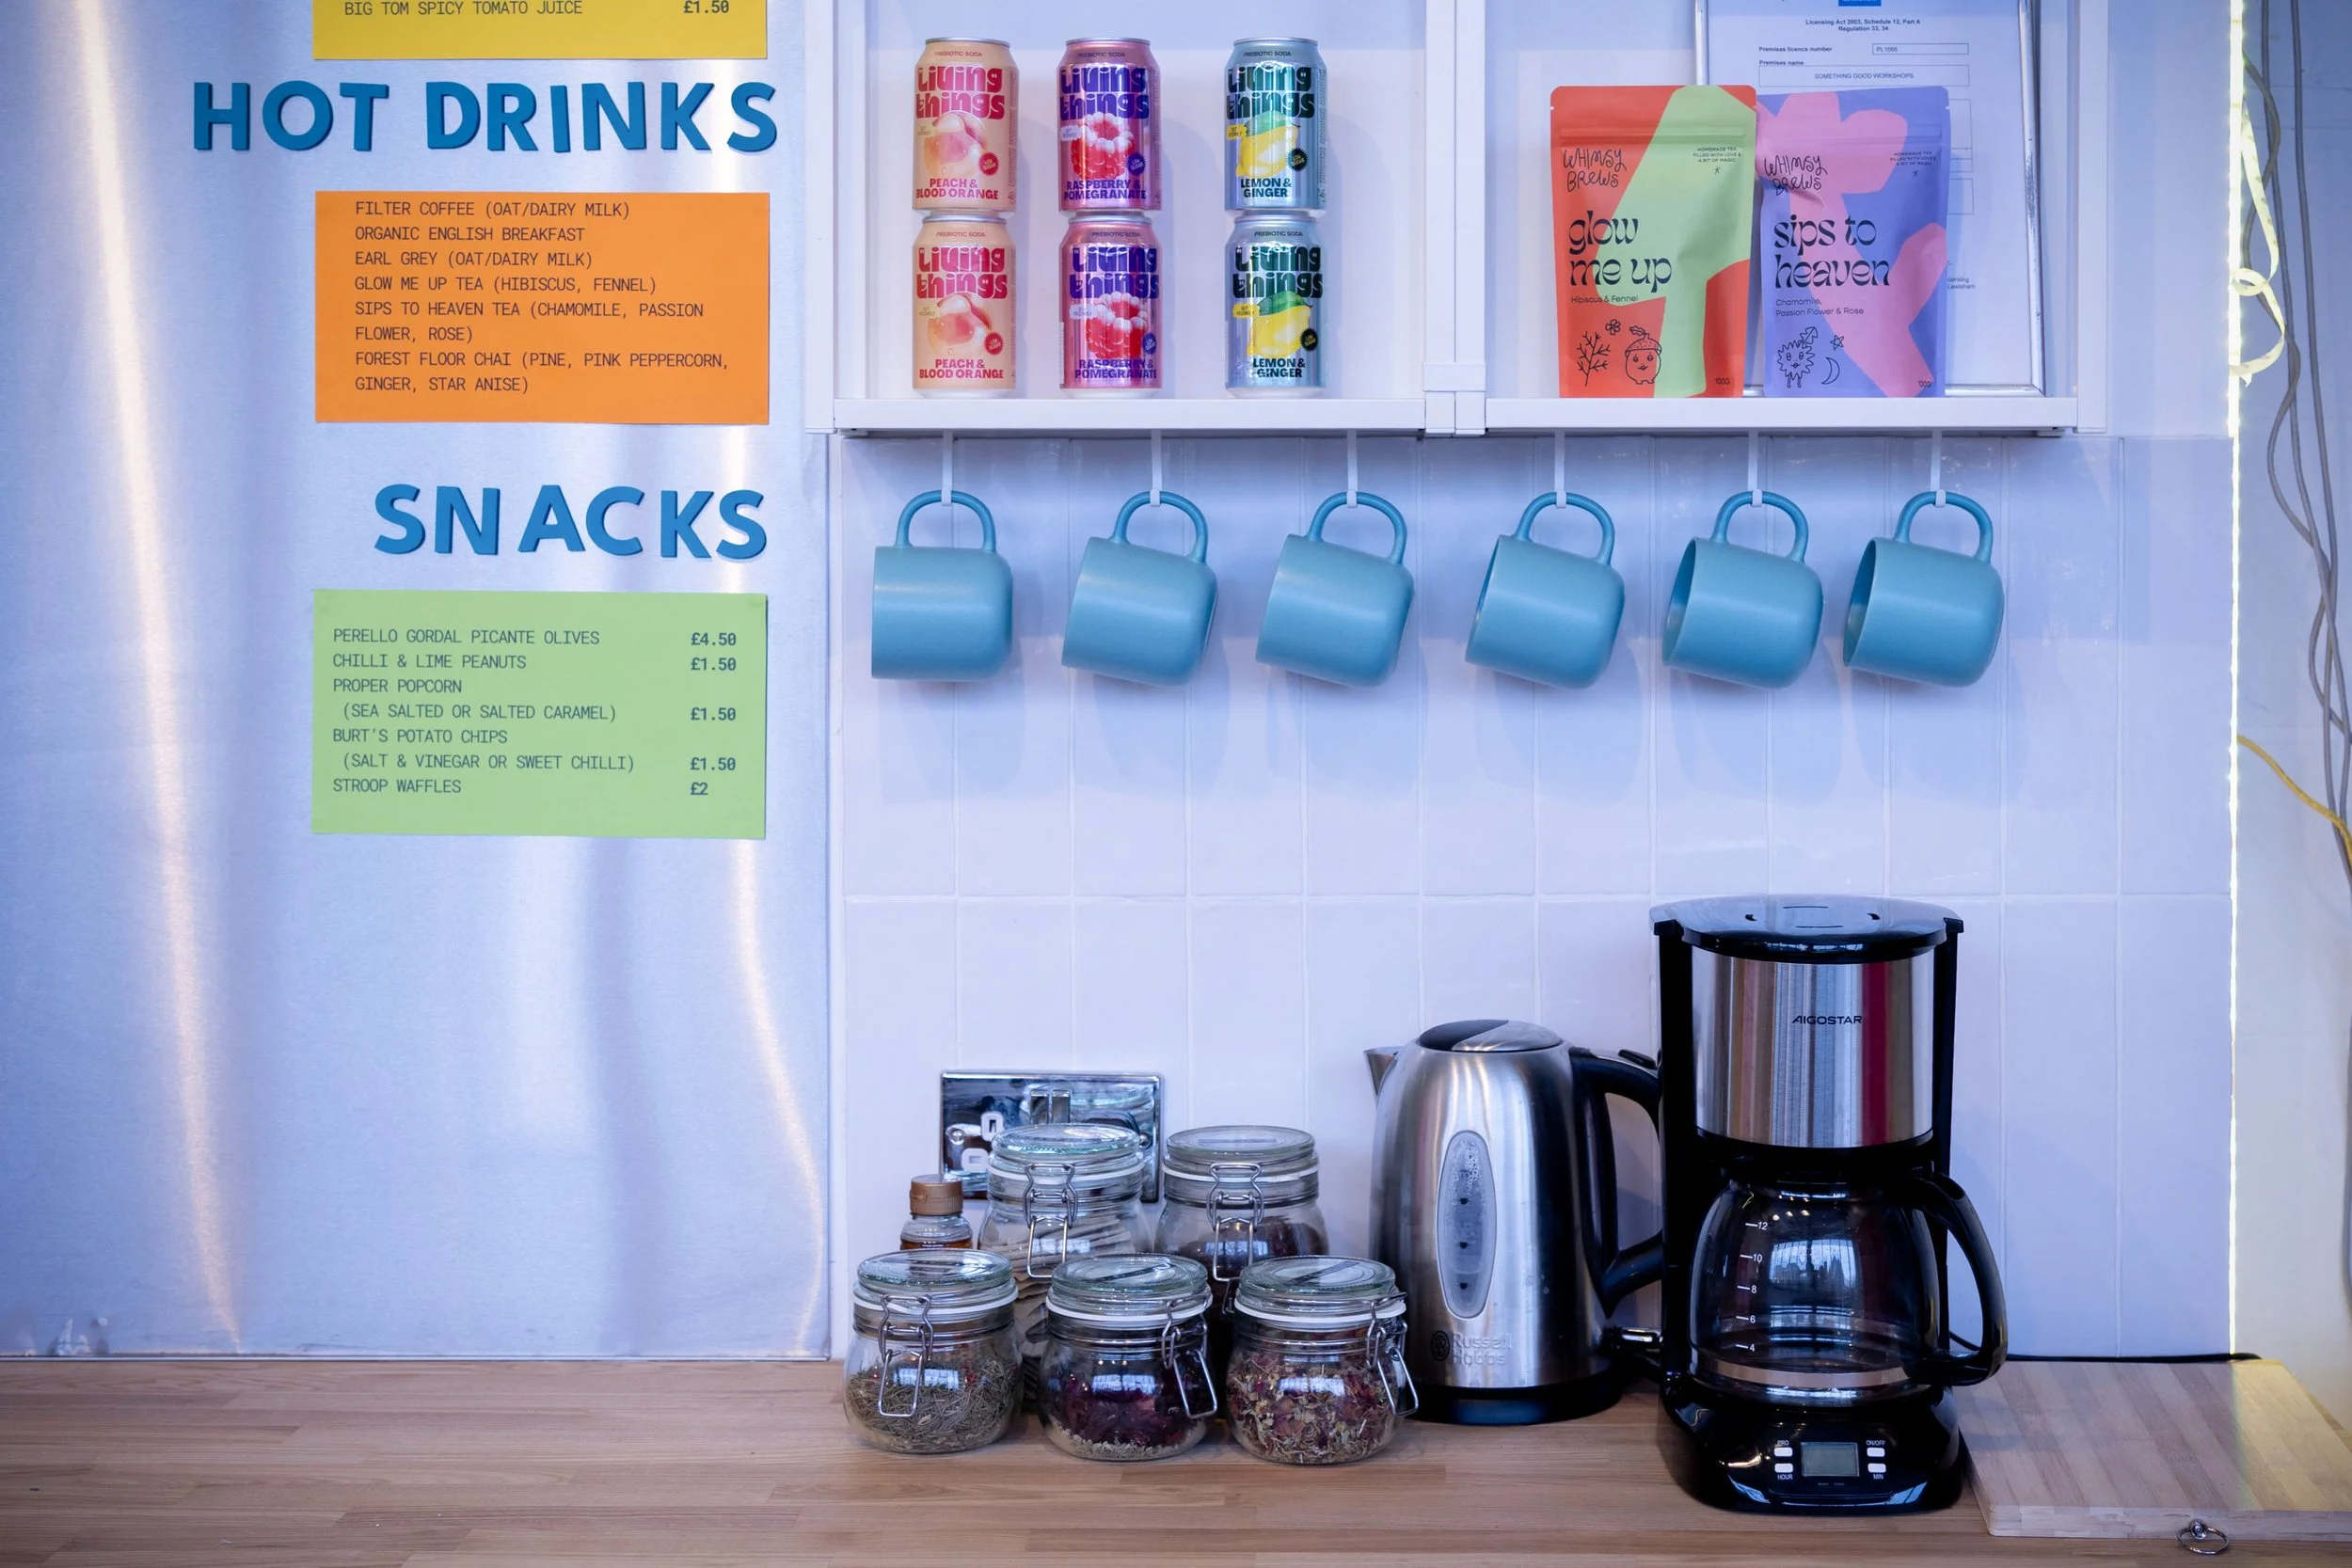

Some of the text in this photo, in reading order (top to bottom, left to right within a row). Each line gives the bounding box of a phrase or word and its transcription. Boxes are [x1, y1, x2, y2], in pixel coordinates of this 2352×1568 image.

[344, 0, 583, 16] BIG TOM SPICY TOMATO JUICE
[683, 0, 730, 14] £1.50
[916, 93, 1005, 119] things
[1060, 93, 1149, 120] things
[1227, 92, 1315, 119] things
[193, 81, 778, 152] HOT DRINKS
[930, 178, 977, 188] PEACH &
[1067, 179, 1131, 190] RASPBERRY
[1241, 178, 1292, 188] LEMON &
[916, 188, 998, 199] BLOOD ORANGE
[1064, 189, 1146, 200] POMEGRANATE
[1244, 188, 1288, 198] GINGER
[356, 200, 629, 221] FILTER COFFEE (OAT/DAIRY MILK)
[355, 226, 586, 242] ORGANIC ENGLISH BREAKFAST
[1568, 210, 1639, 255] glow
[1773, 214, 1877, 256] sips to
[355, 250, 593, 271] EARL GREY (OAT/DAIRY MILK)
[1569, 258, 1672, 293] me up
[1774, 254, 1890, 289] heaven
[354, 276, 656, 295] GLOW ME UP TEA (HIBISCUS, FENNEL)
[916, 273, 1008, 299] things
[1070, 273, 1159, 299] things
[1232, 272, 1323, 298] things
[1571, 295, 1603, 304] Hibiscus
[1611, 294, 1639, 303] Fennel
[355, 301, 704, 320] SIPS TO HEAVEN TEA (CHAMOMILE, PASSION
[1776, 307, 1864, 317] Passion Flower & Rose
[355, 325, 473, 345] FLOWER, ROSE)
[356, 351, 727, 371] FOREST FLOOR CHAI (PINE, PINK PEPPERCORN,
[935, 359, 985, 368] PEACH &
[1079, 359, 1153, 369] RASPBERRY &
[1253, 358, 1305, 368] LEMON &
[919, 370, 1004, 378] BLOOD ORANGE
[1257, 369, 1302, 377] GINGER
[355, 375, 529, 395] GINGER, STAR ANISE)
[373, 483, 767, 560] SNACKS
[333, 627, 600, 645] PERELLO GORDAL PICANTE OLIVES
[691, 631, 737, 646] £4.50
[332, 653, 527, 670] CHILLI & LIME PEANUTS
[691, 657, 737, 672] £1.50
[333, 677, 463, 693] PROPER POPCORN
[343, 702, 616, 723] (SEA SALTED OR SALTED CARAMEL)
[690, 706, 737, 721] £1.50
[332, 727, 508, 745] BURT'S POTATO CHIPS
[343, 752, 634, 773] (SALT & VINEGAR OR SWEET CHILLI)
[690, 756, 737, 771] £1.50
[332, 777, 462, 794] STROOP WAFFLES
[690, 781, 708, 796] £2
[1791, 1015, 1863, 1024] AIGOSTAR
[1757, 1222, 1768, 1230] 12
[1753, 1253, 1763, 1262] 10
[1751, 1285, 1757, 1293] 8
[1750, 1315, 1756, 1323] 6
[1453, 1332, 1513, 1349] Russell
[1749, 1343, 1756, 1352] 4
